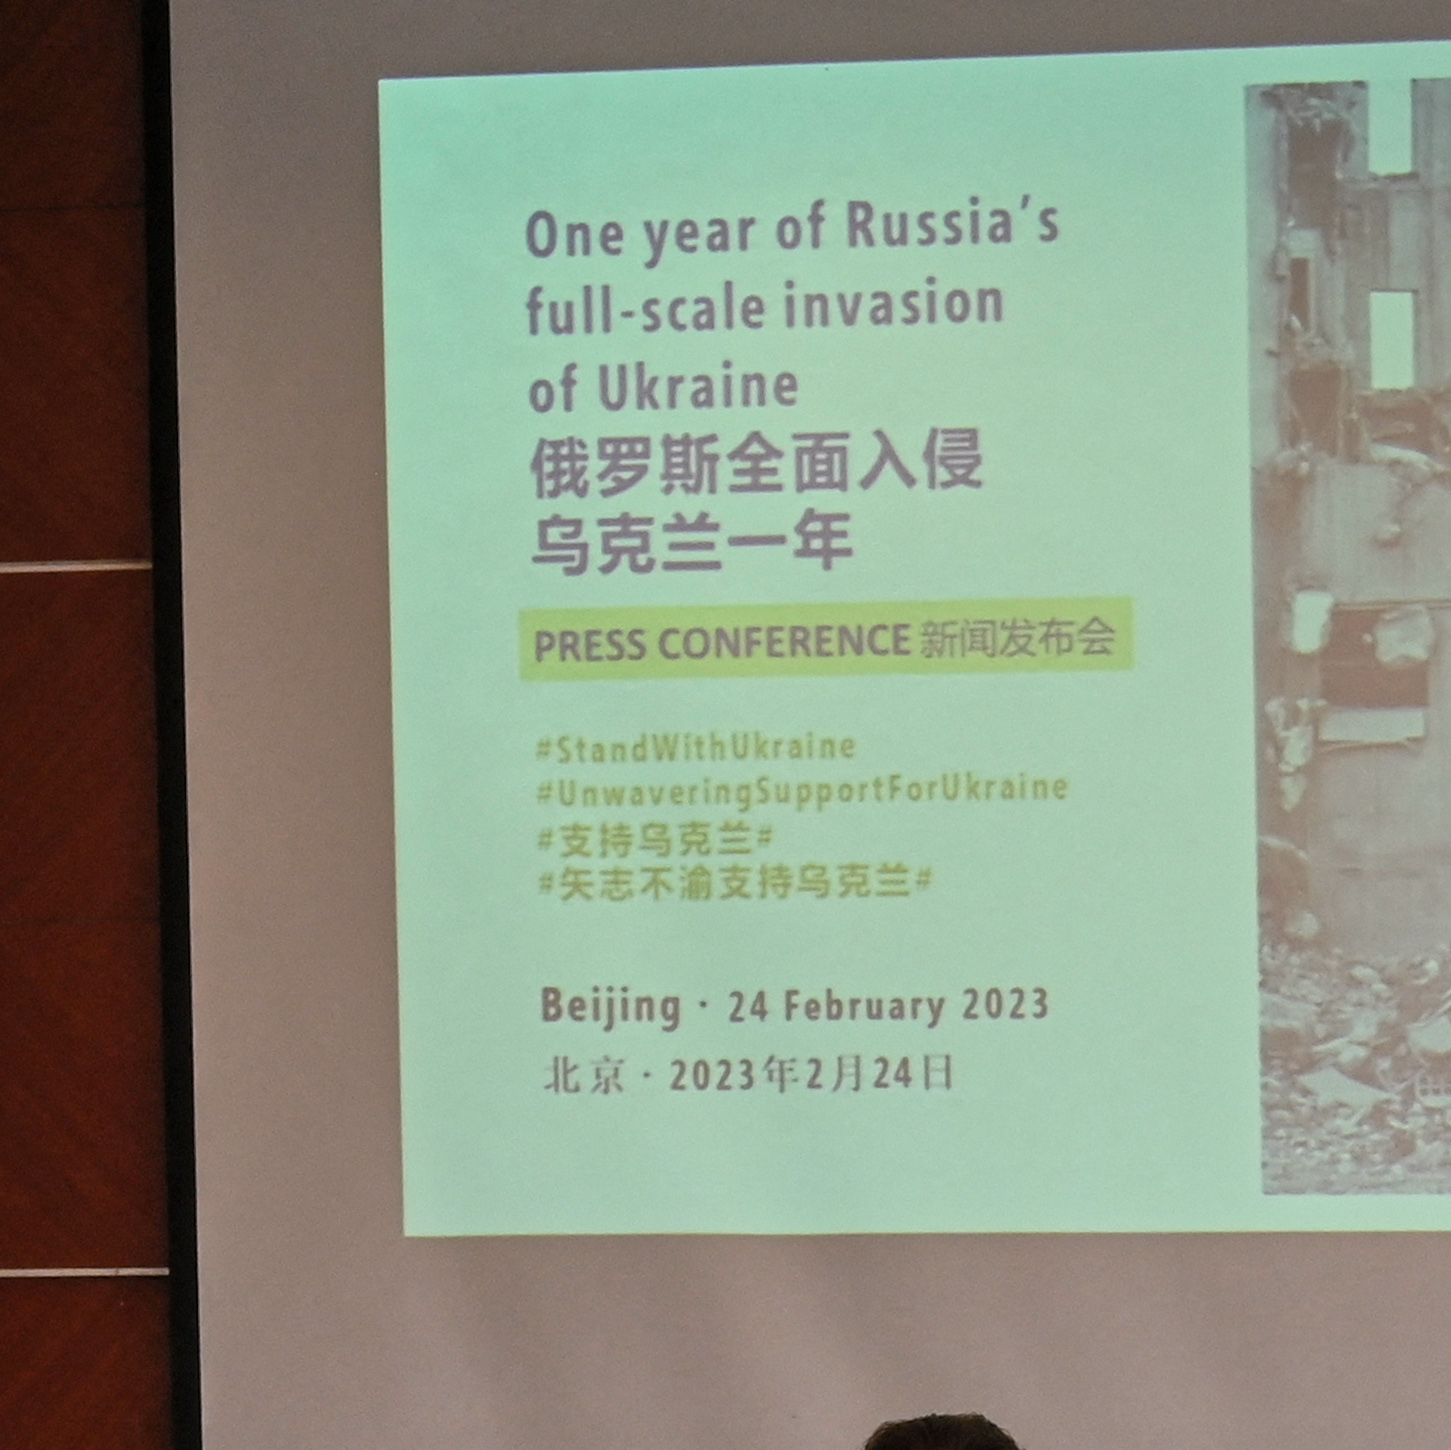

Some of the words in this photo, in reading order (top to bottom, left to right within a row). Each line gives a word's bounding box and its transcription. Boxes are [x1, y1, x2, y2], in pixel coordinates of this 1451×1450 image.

[526, 209, 624, 258] One
[643, 217, 756, 269] year
[775, 198, 826, 250] of
[847, 194, 1060, 248] Russia's
[525, 280, 765, 336] full-scale
[784, 276, 1003, 328] invasion
[529, 362, 578, 414] of
[599, 359, 798, 411] Ukraine
[530, 427, 983, 499] 俄罗斯全面入侵
[531, 508, 853, 576] 乌克兰一年
[535, 628, 647, 663] PRESS
[658, 623, 912, 661] CONFERENCE
[920, 616, 1116, 659] 新闻发布会
[536, 731, 856, 764] #StandWithUkraine
[536, 774, 1069, 812] #UnwaveringSupportForUkraine
[537, 821, 773, 858] #支持乌克兰#
[541, 986, 681, 1032] Beijing
[728, 990, 768, 1023] 24
[784, 988, 945, 1029] February
[962, 987, 1049, 1020] 2023
